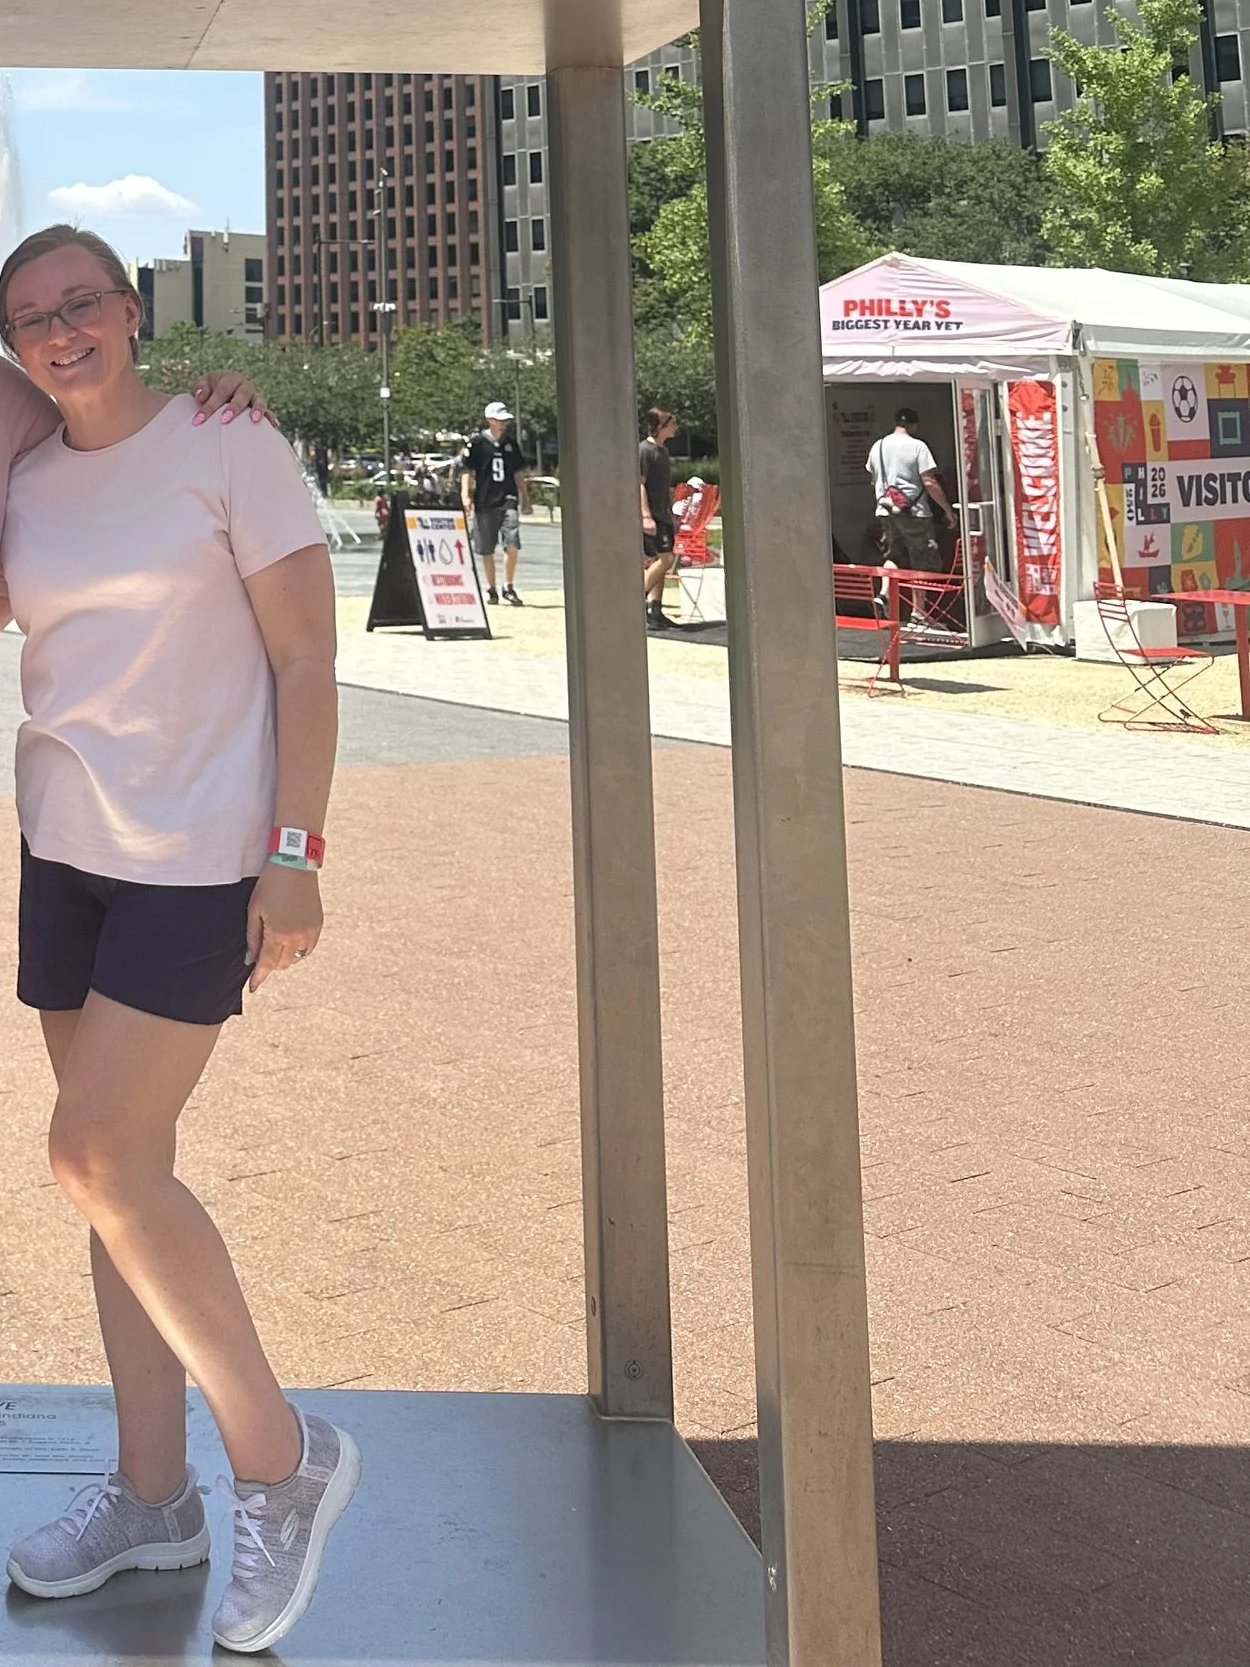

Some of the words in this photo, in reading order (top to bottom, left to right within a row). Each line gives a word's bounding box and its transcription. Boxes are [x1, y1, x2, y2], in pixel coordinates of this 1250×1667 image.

[843, 299, 952, 319] PHILLY'S
[832, 319, 890, 331] BIGGEST
[893, 319, 932, 331] YEAR
[934, 321, 964, 331] YET
[492, 457, 505, 482] 9
[1151, 466, 1166, 483] 20
[1015, 410, 1059, 557] WELCOME
[1151, 483, 1167, 498] 26
